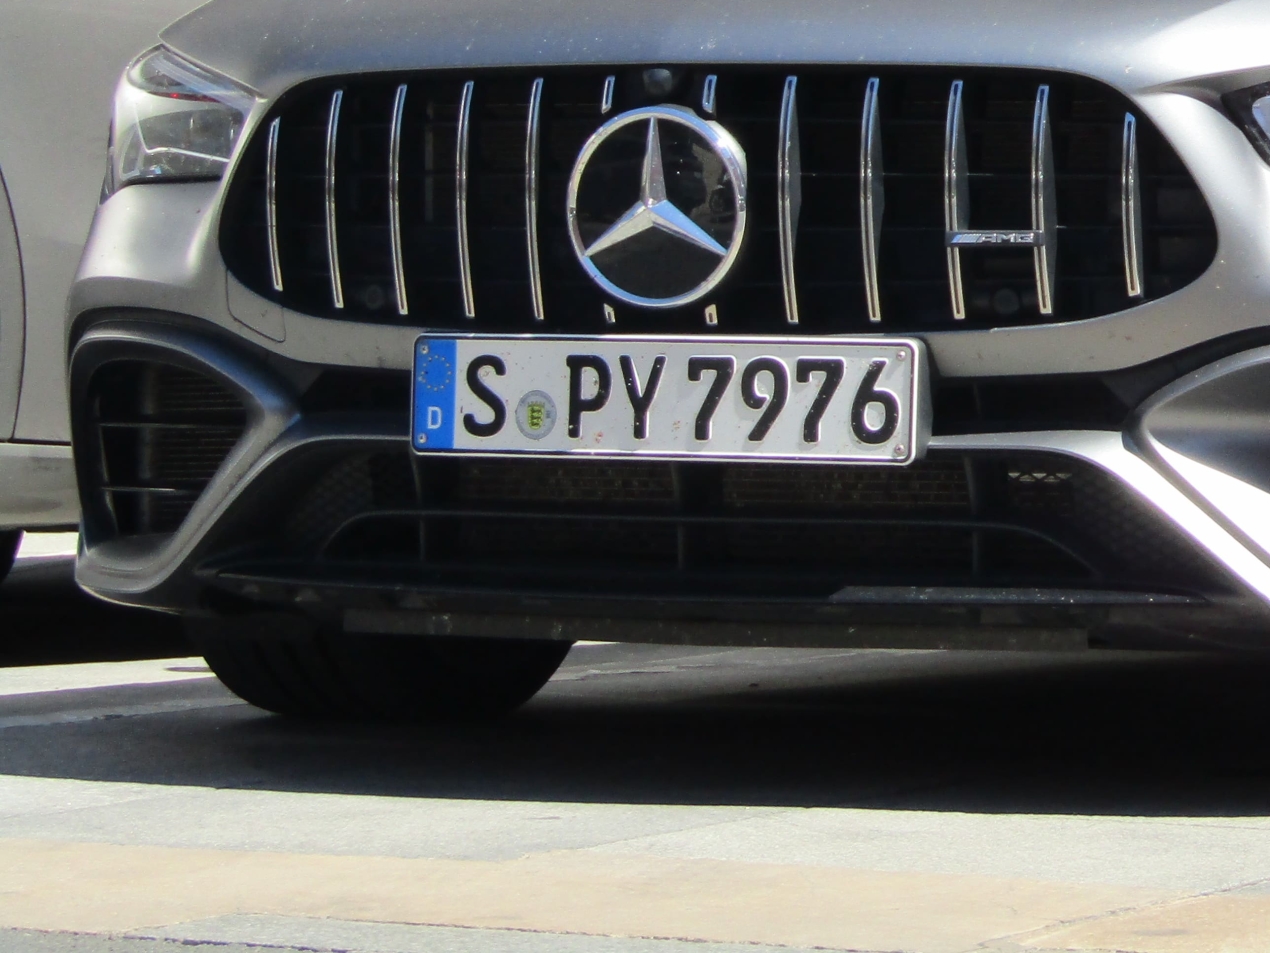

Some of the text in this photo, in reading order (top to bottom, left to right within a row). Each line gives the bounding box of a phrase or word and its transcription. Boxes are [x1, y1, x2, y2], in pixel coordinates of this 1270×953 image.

[976, 232, 1034, 243] AMG
[462, 353, 901, 445] S PY 7976
[427, 406, 443, 430] D
